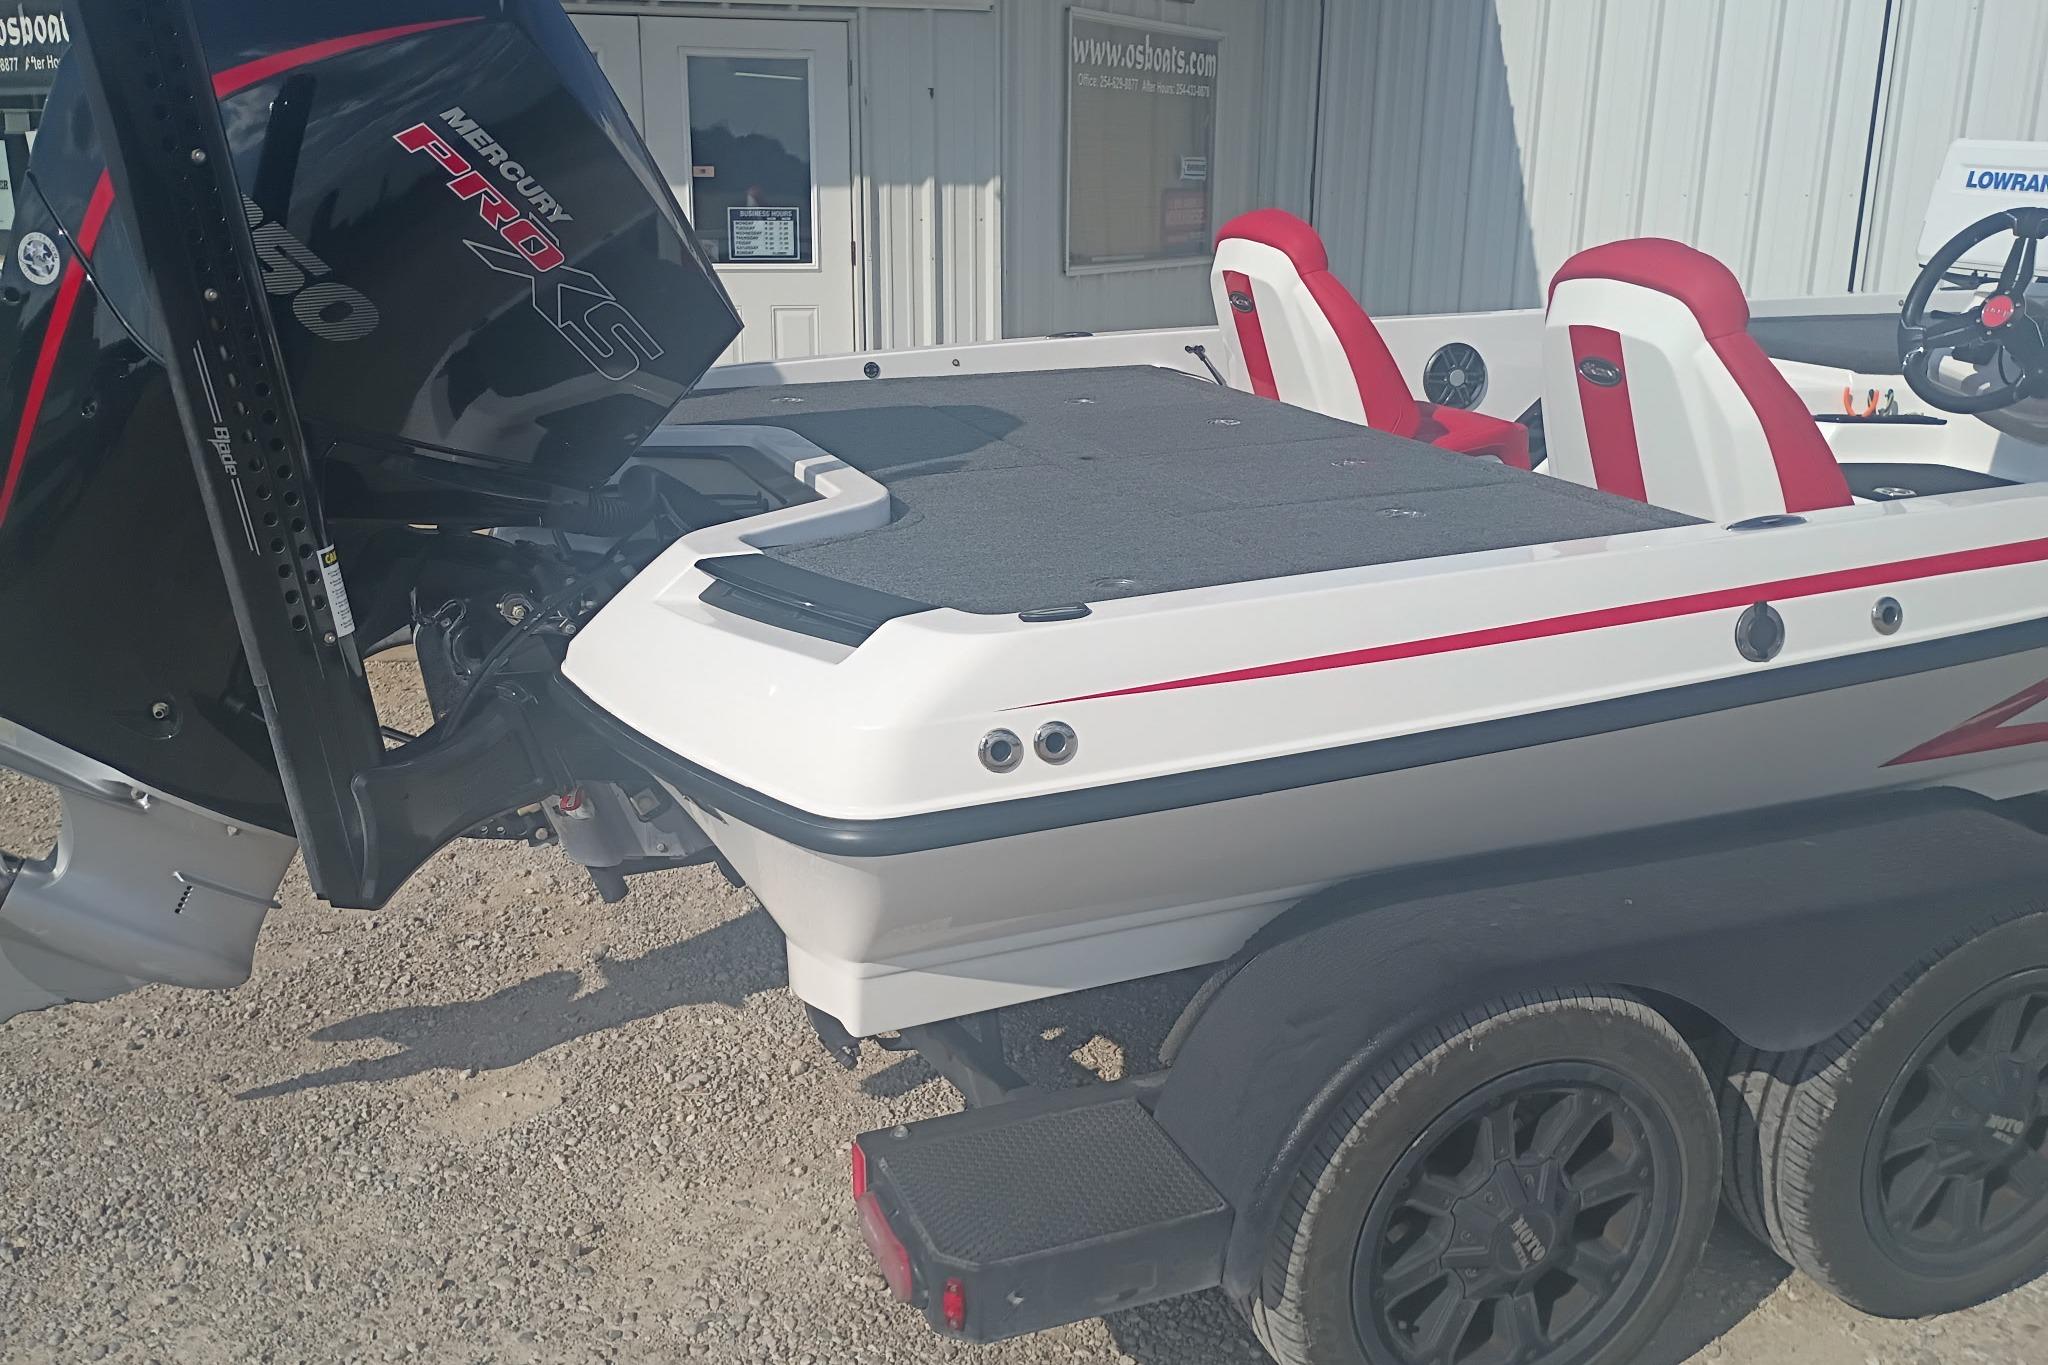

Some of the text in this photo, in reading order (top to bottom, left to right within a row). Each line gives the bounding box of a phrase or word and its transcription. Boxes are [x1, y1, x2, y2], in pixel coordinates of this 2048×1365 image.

[1073, 34, 1217, 78] www.osboats.com
[392, 122, 565, 272] PRO
[439, 106, 573, 224] MERCURY
[463, 212, 664, 380] XS
[207, 426, 237, 476] Blade
[1511, 1214, 1546, 1261] MOTO
